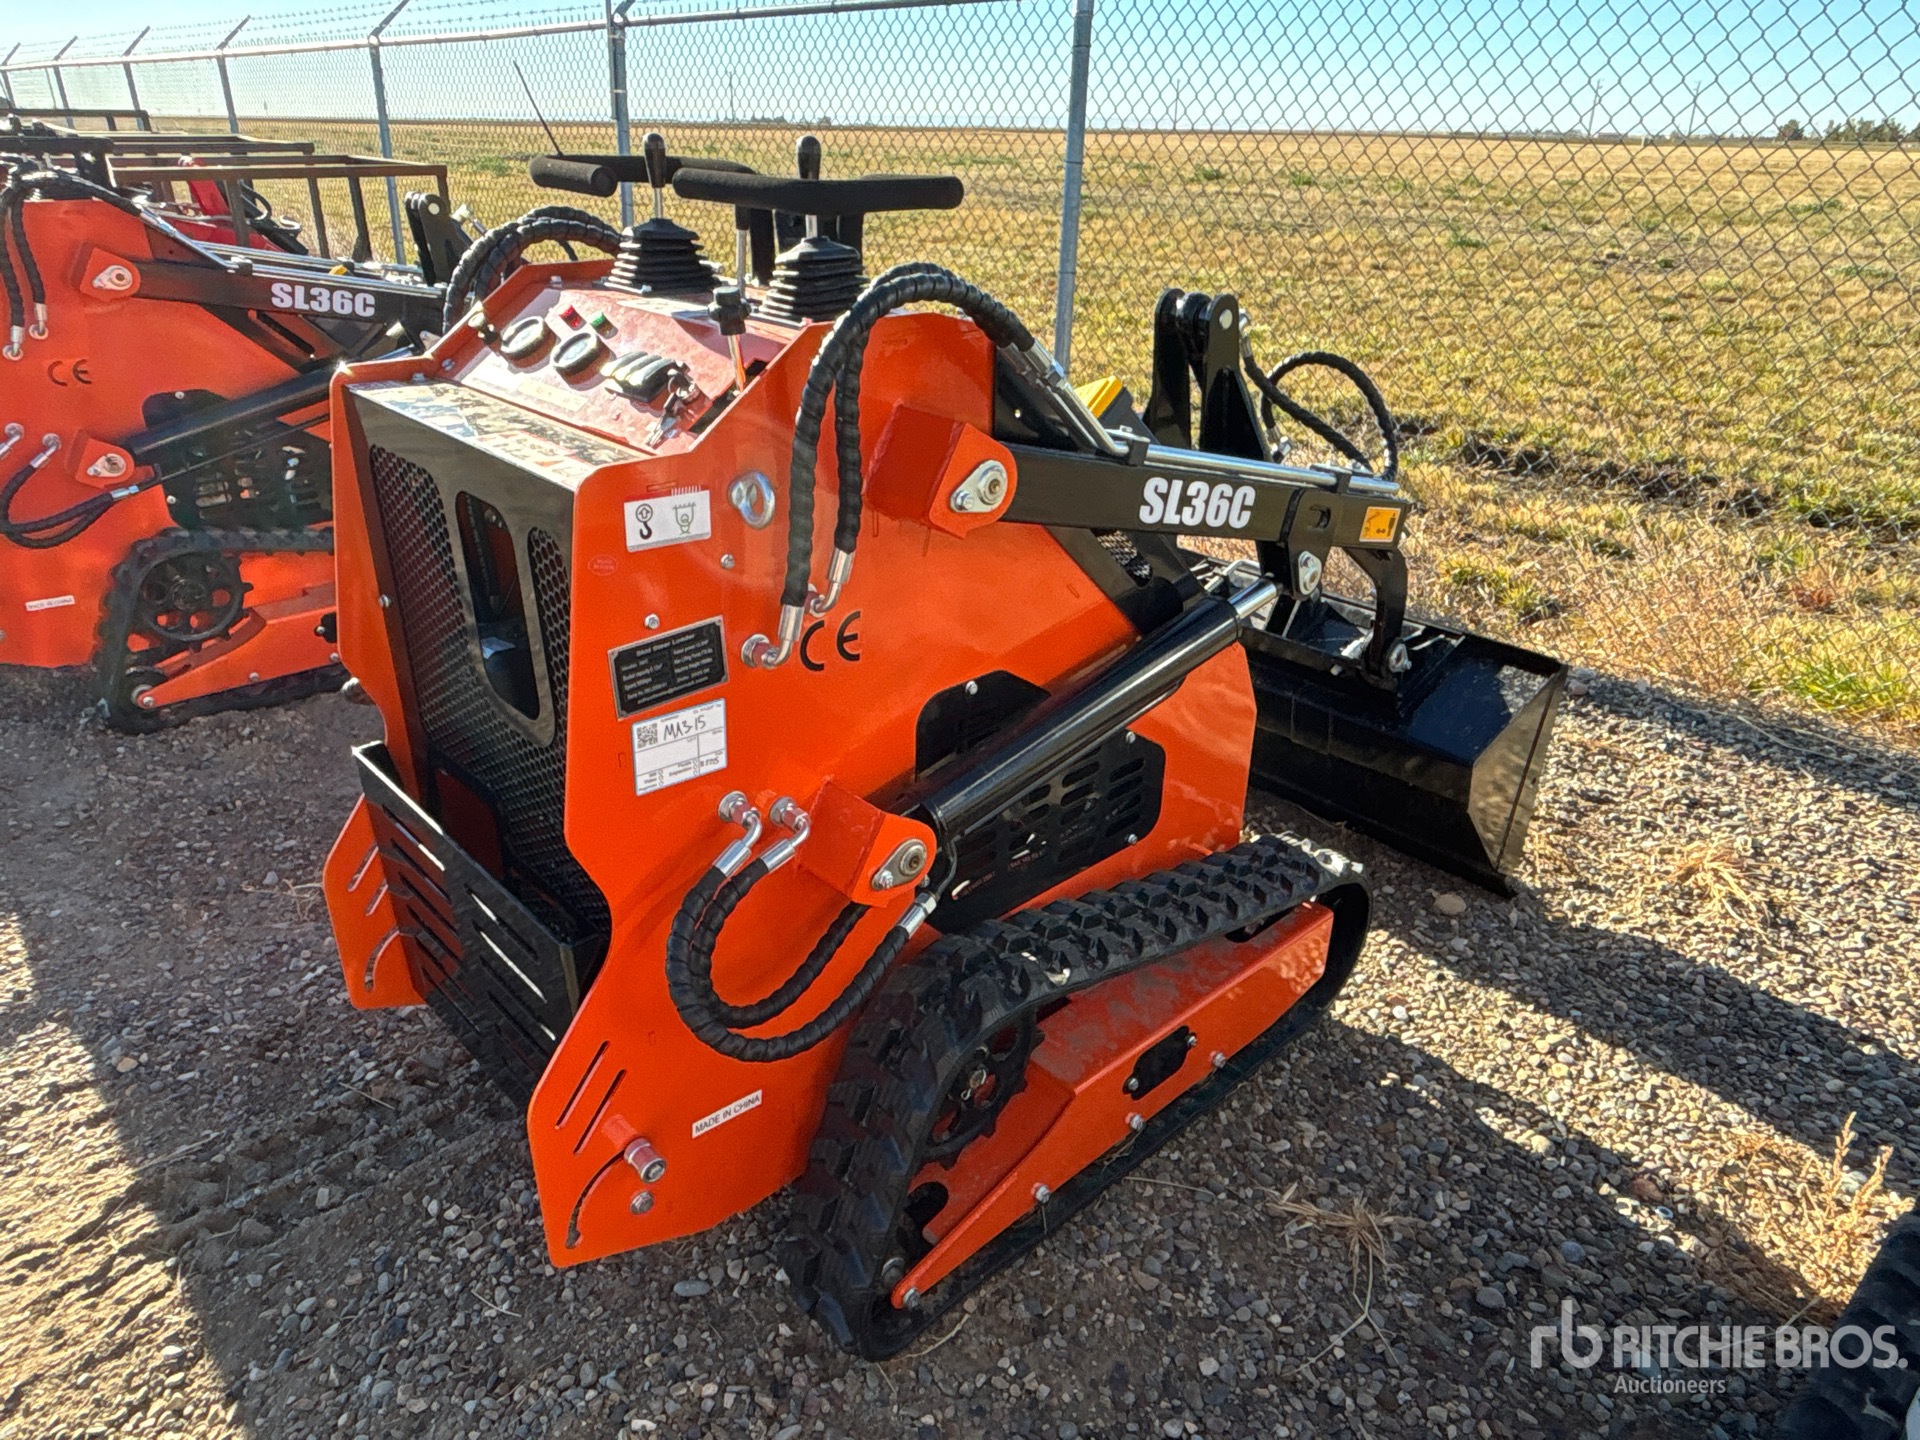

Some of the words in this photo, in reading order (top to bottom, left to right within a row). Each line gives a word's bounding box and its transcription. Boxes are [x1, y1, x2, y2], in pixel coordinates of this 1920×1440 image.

[271, 282, 376, 317] SL36C
[1139, 477, 1256, 529] SL36C
[800, 610, 861, 672] CE
[695, 1114, 721, 1133] MADE
[722, 1108, 732, 1120] IN
[733, 1095, 760, 1113] CHINA
